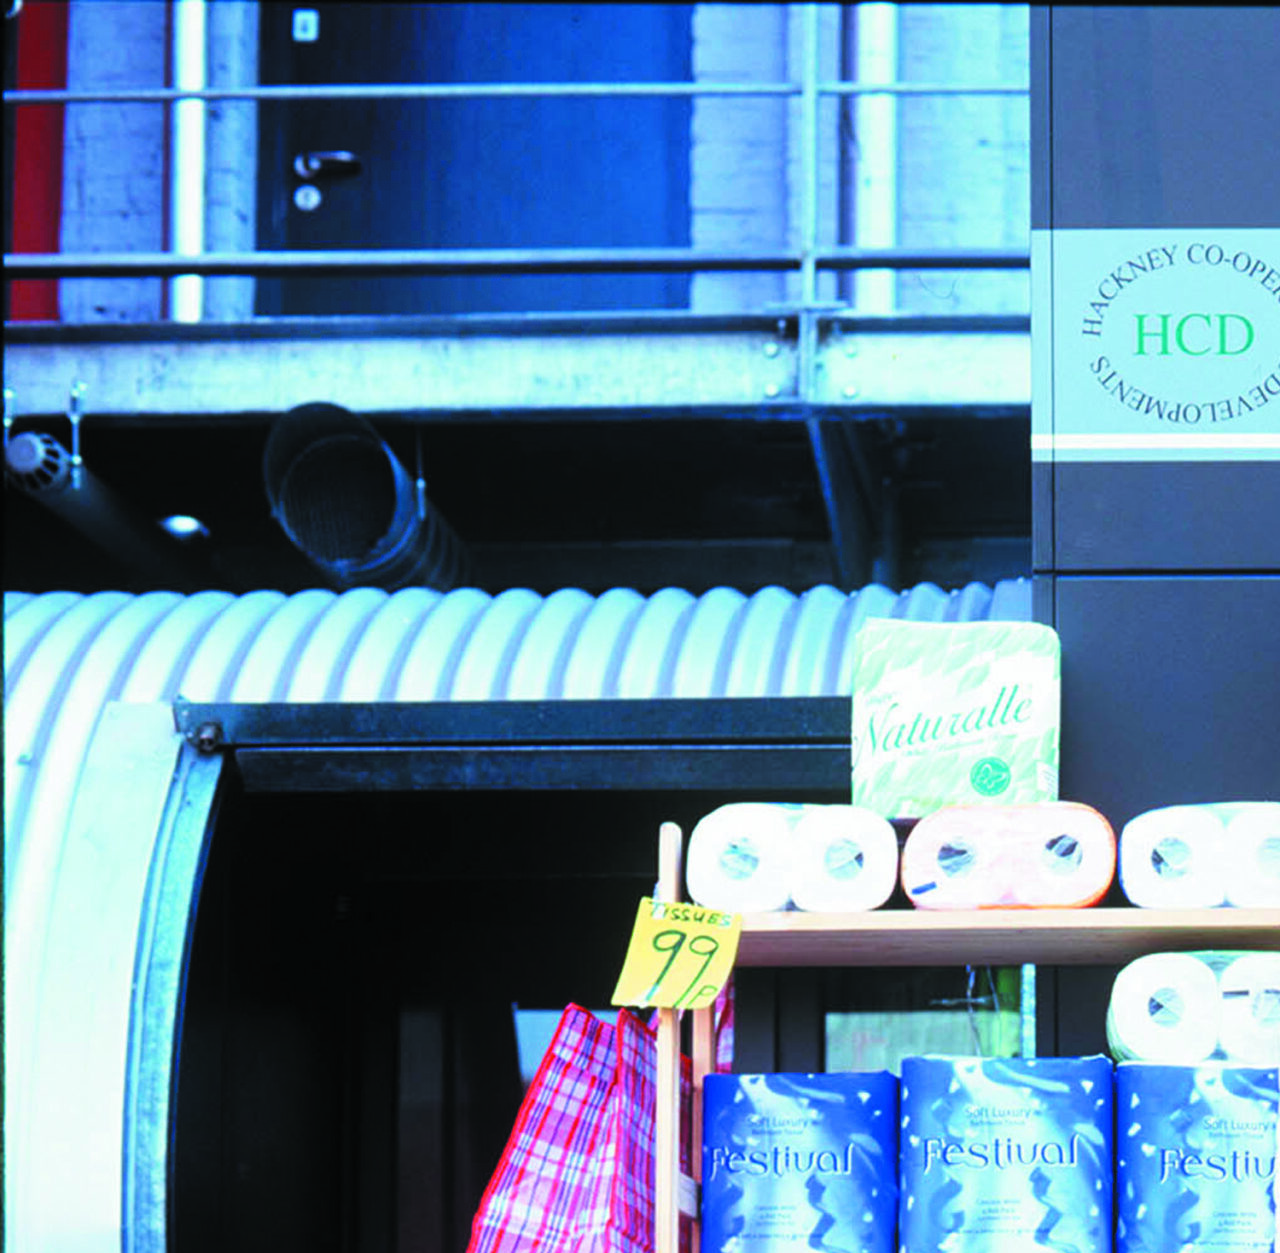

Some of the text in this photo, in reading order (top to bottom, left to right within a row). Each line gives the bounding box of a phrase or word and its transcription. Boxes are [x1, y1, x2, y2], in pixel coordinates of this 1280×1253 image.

[1082, 243, 1178, 337] HACKNEY
[1134, 313, 1255, 356] HCD
[858, 684, 1032, 758] Naturalle
[648, 901, 732, 927] TISSUES
[652, 929, 720, 1008] 99p
[711, 1143, 855, 1181] Festival
[923, 1134, 1080, 1177] Festival
